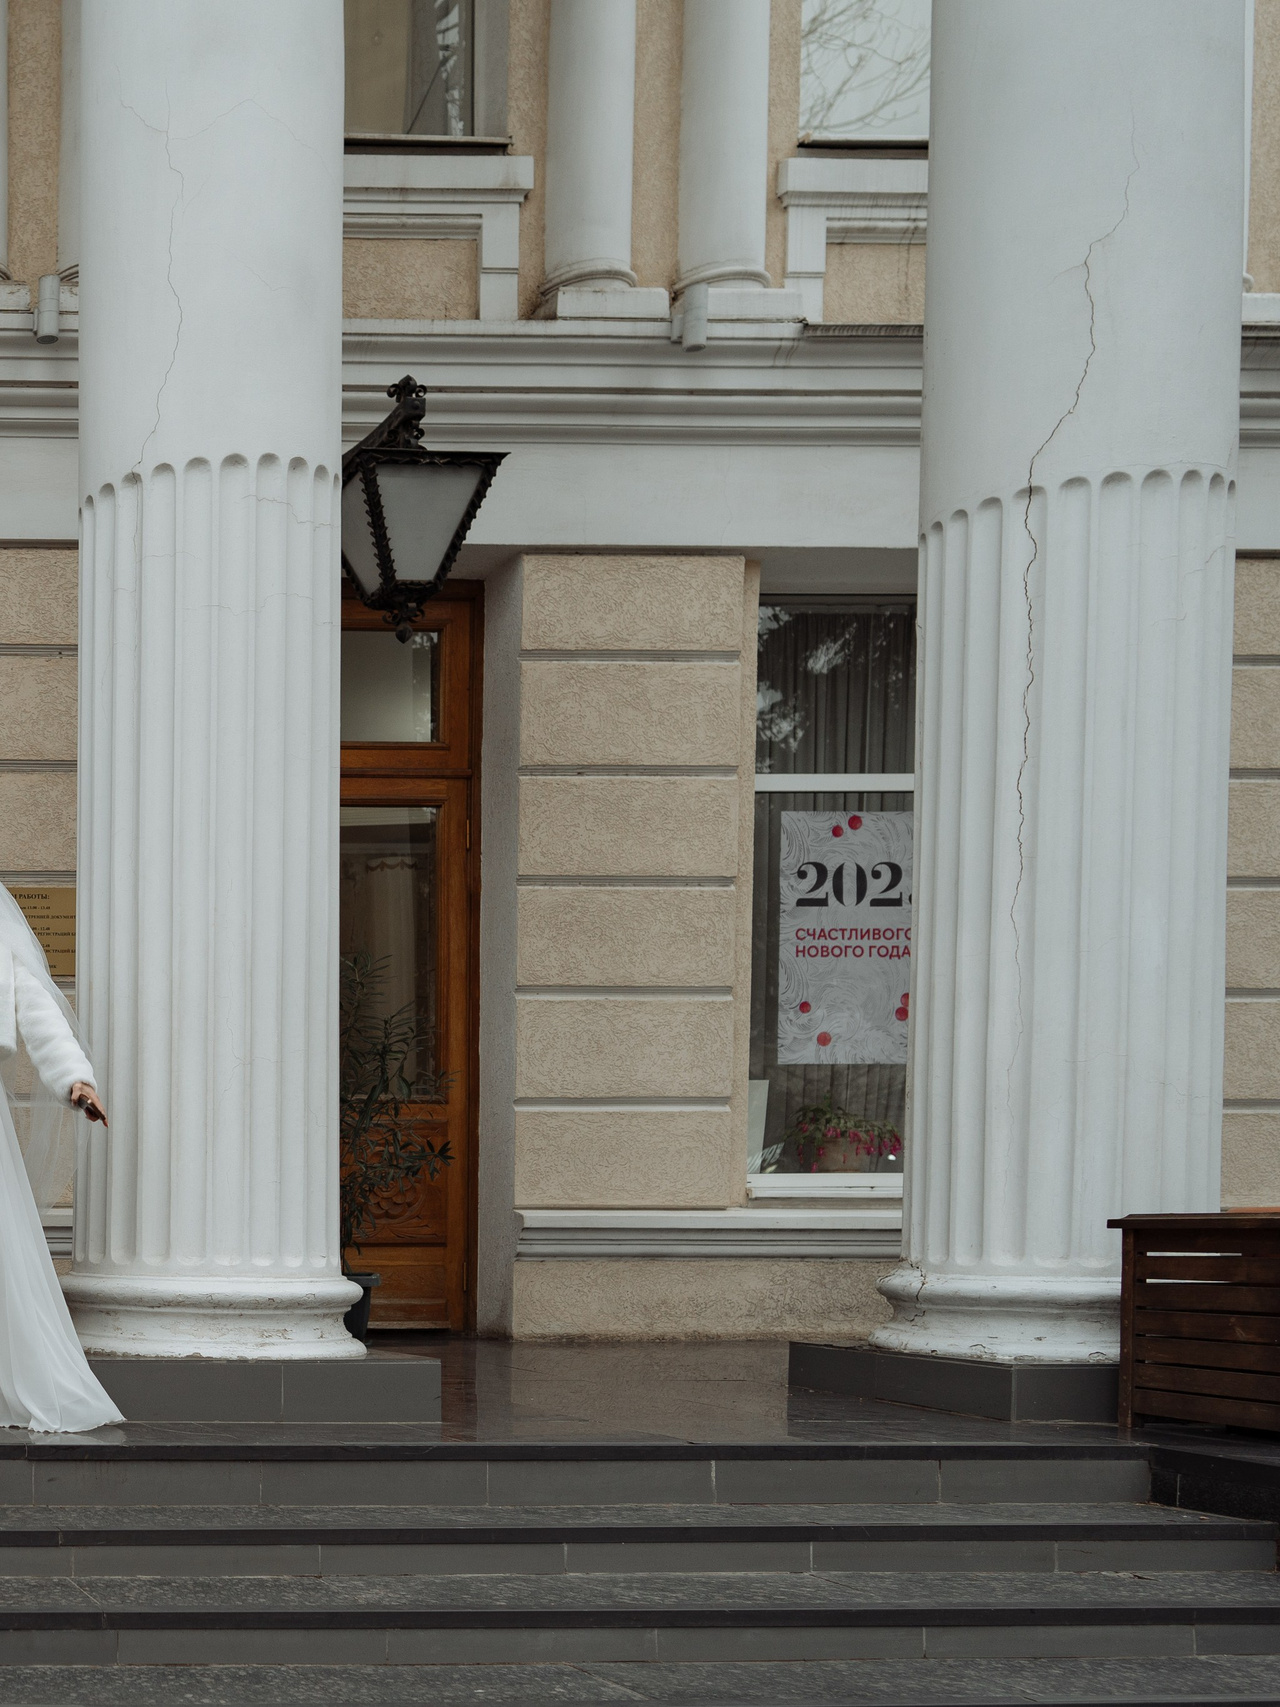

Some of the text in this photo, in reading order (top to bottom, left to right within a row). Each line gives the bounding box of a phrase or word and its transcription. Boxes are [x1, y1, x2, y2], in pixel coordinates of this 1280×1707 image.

[796, 861, 912, 907] 202
[795, 946, 911, 959] НОВОГО ГОДА
